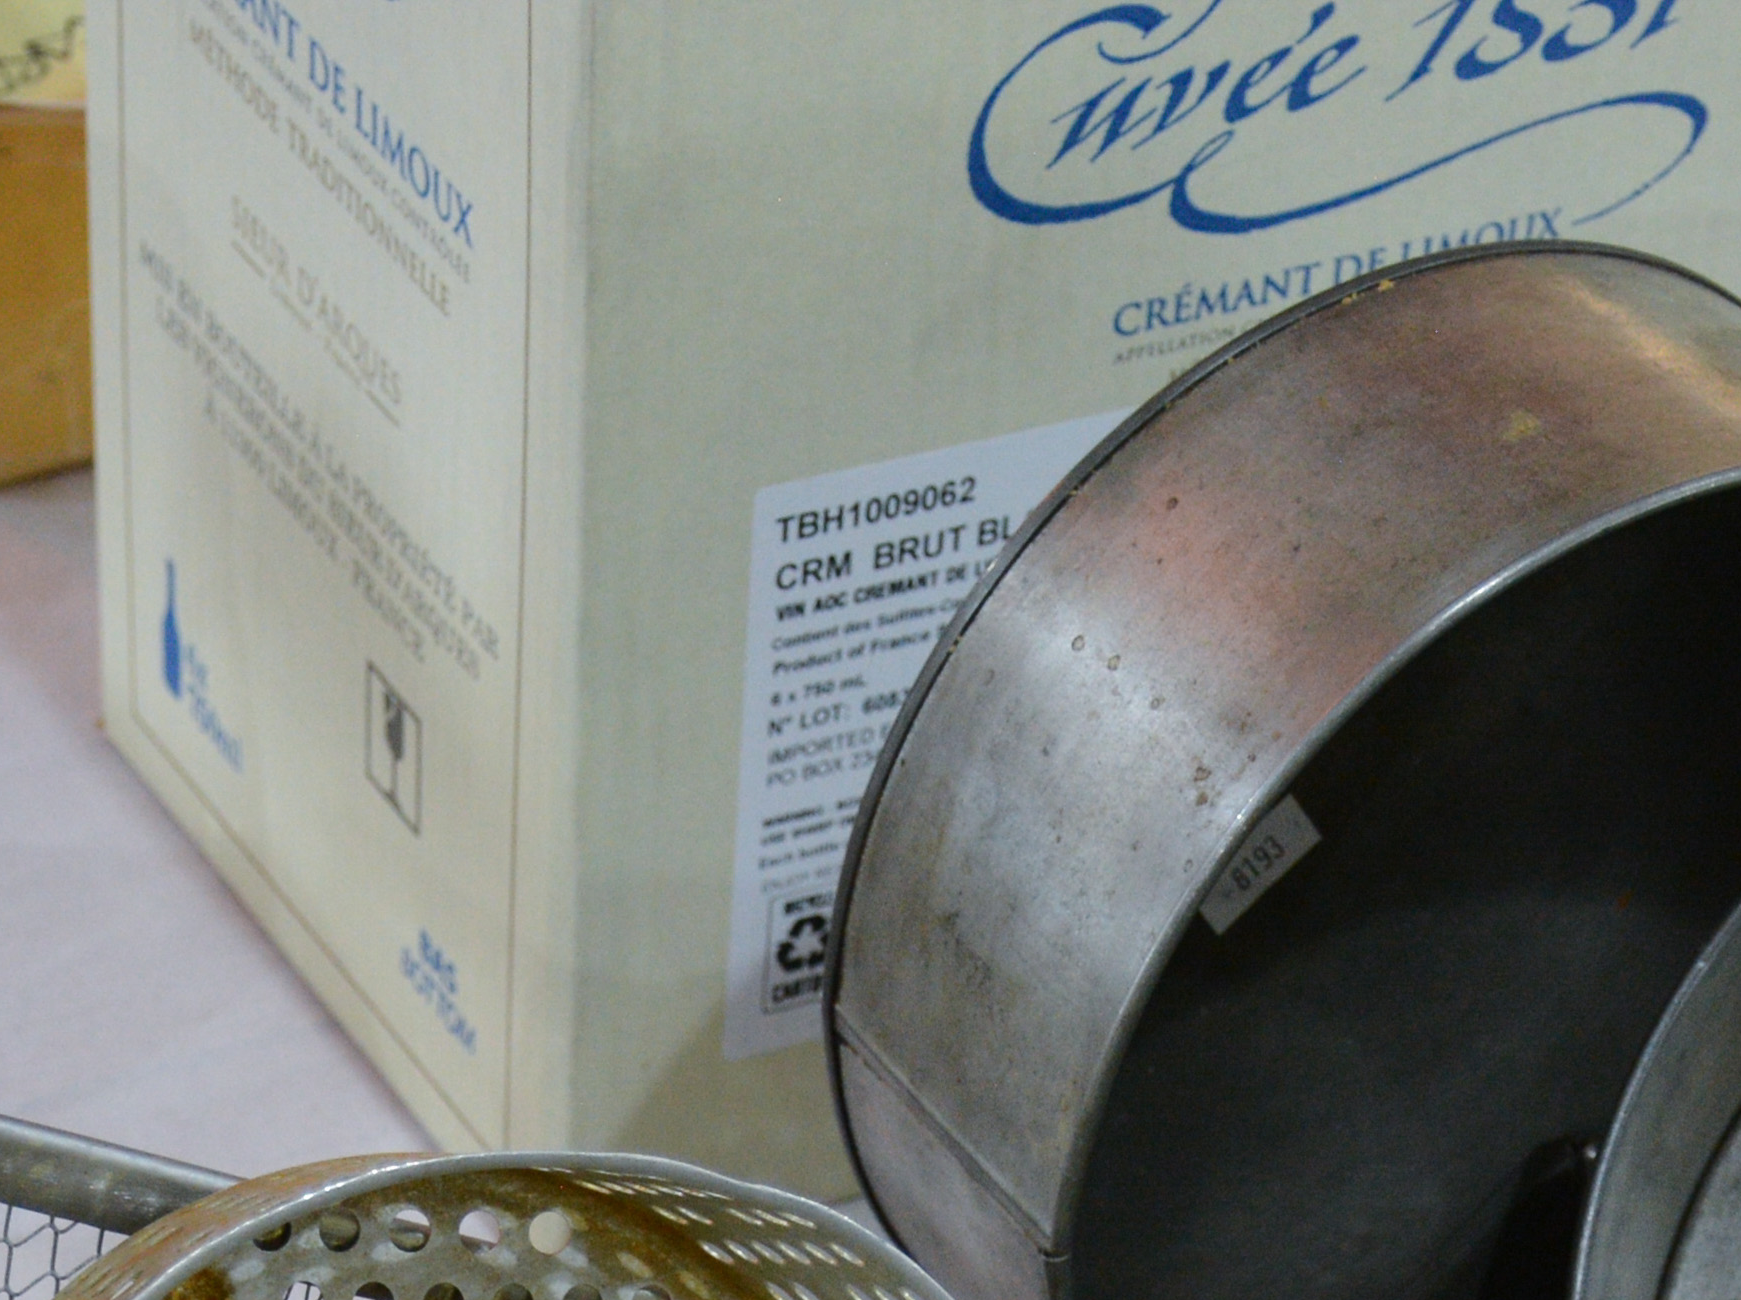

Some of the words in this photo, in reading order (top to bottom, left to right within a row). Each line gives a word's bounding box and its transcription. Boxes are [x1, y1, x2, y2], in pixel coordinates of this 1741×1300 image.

[308, 38, 347, 115] DE
[354, 84, 473, 249] LIMOUX
[1113, 258, 1326, 338] CRÉMANT
[1334, 244, 1388, 288] DE
[776, 475, 977, 543] TBH1009062
[774, 551, 853, 590] CRM
[871, 523, 967, 570] BRUT
[852, 569, 940, 604] CREMANT
[767, 726, 875, 766] IMPORTED
[801, 757, 843, 782] BOX
